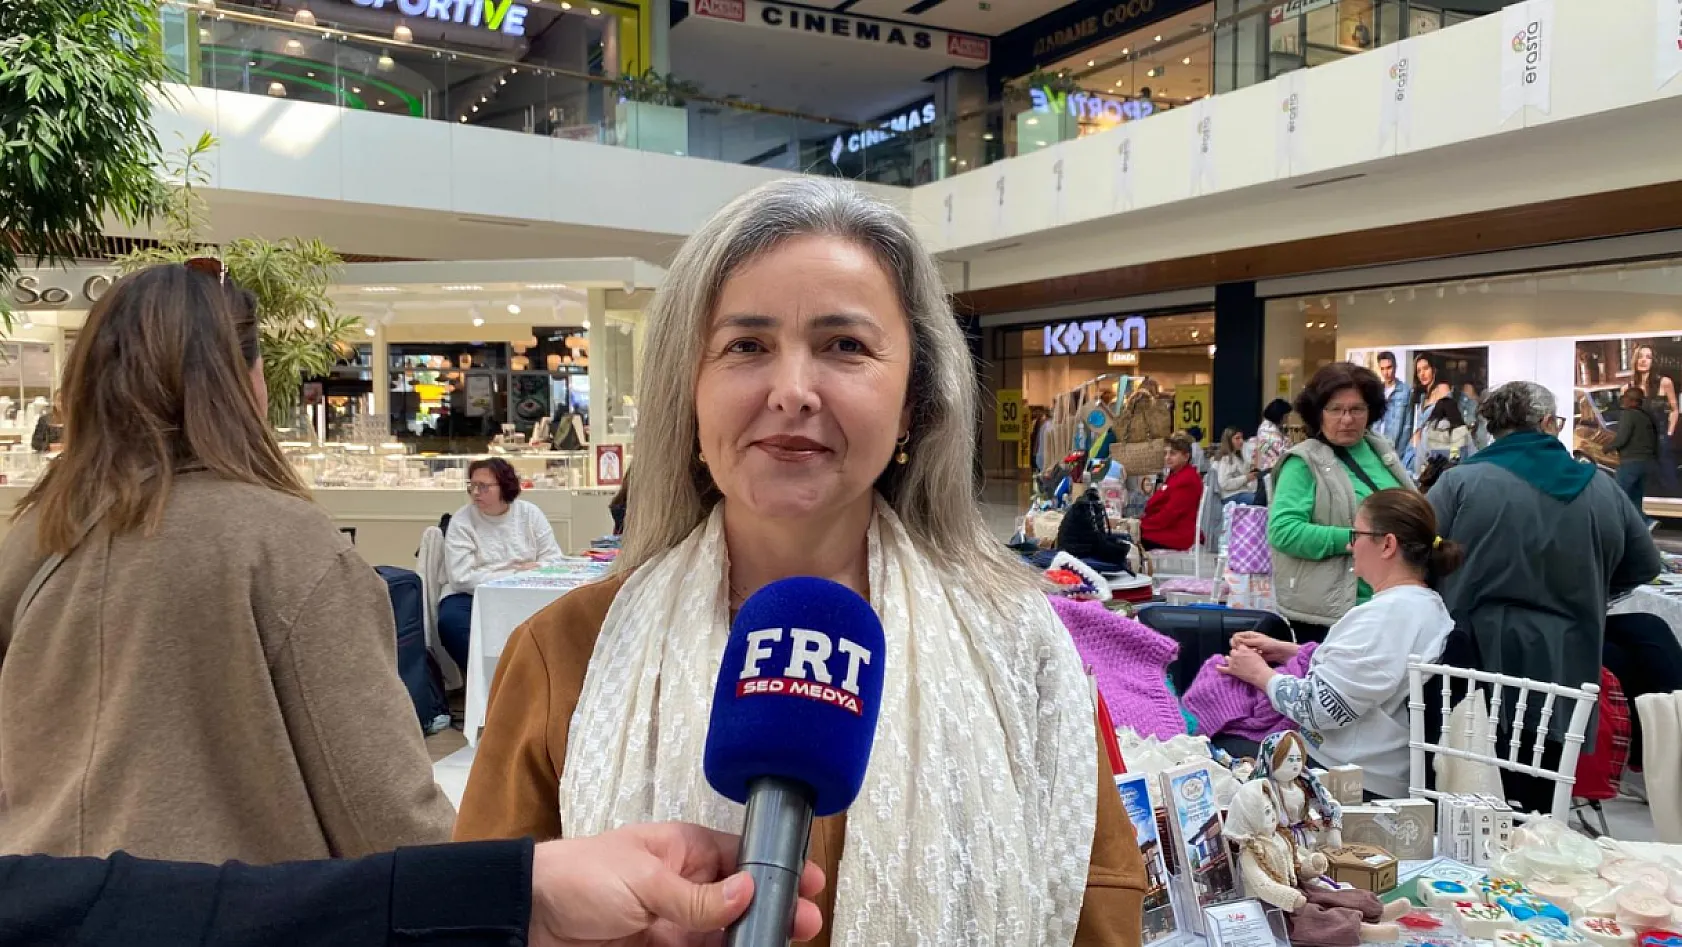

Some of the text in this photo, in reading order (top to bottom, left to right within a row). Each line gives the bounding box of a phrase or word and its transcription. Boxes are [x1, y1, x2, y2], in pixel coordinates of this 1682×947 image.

[354, 0, 528, 36] ORTIVE
[761, 7, 931, 48] CINEMAS
[1103, 0, 1154, 27] COCO
[1525, 21, 1539, 84] erasta
[15, 276, 71, 303] So
[1043, 316, 1147, 356] KOTON
[1002, 402, 1018, 421] 50
[1183, 401, 1203, 423] 50
[739, 628, 872, 695] FRT
[743, 680, 859, 713] SED MEDYA
